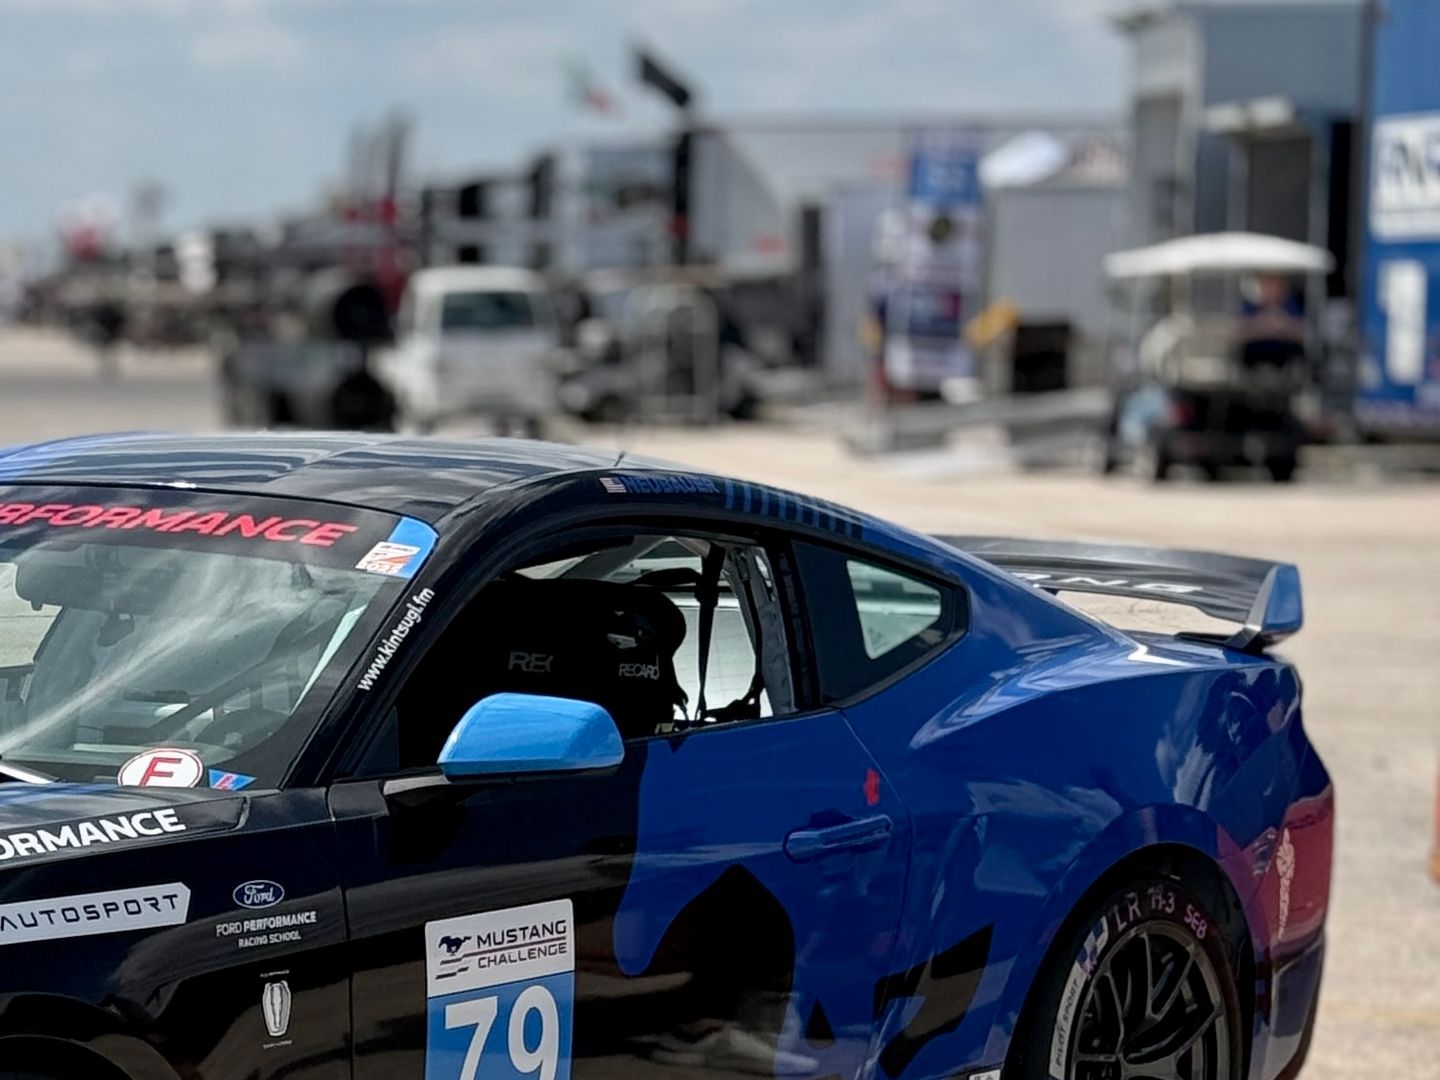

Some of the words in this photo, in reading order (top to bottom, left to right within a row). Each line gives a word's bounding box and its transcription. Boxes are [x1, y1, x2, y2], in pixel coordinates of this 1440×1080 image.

[621, 475, 720, 495] NEUBAUER
[357, 587, 435, 691] www.kintsugi.fm
[244, 884, 276, 905] Ford
[0, 893, 178, 932] AUTOSPORT
[216, 922, 242, 937] FORD
[243, 911, 317, 933] PERFORMANCE
[476, 920, 567, 949] MUSTANG
[477, 942, 568, 970] CHALLENGE
